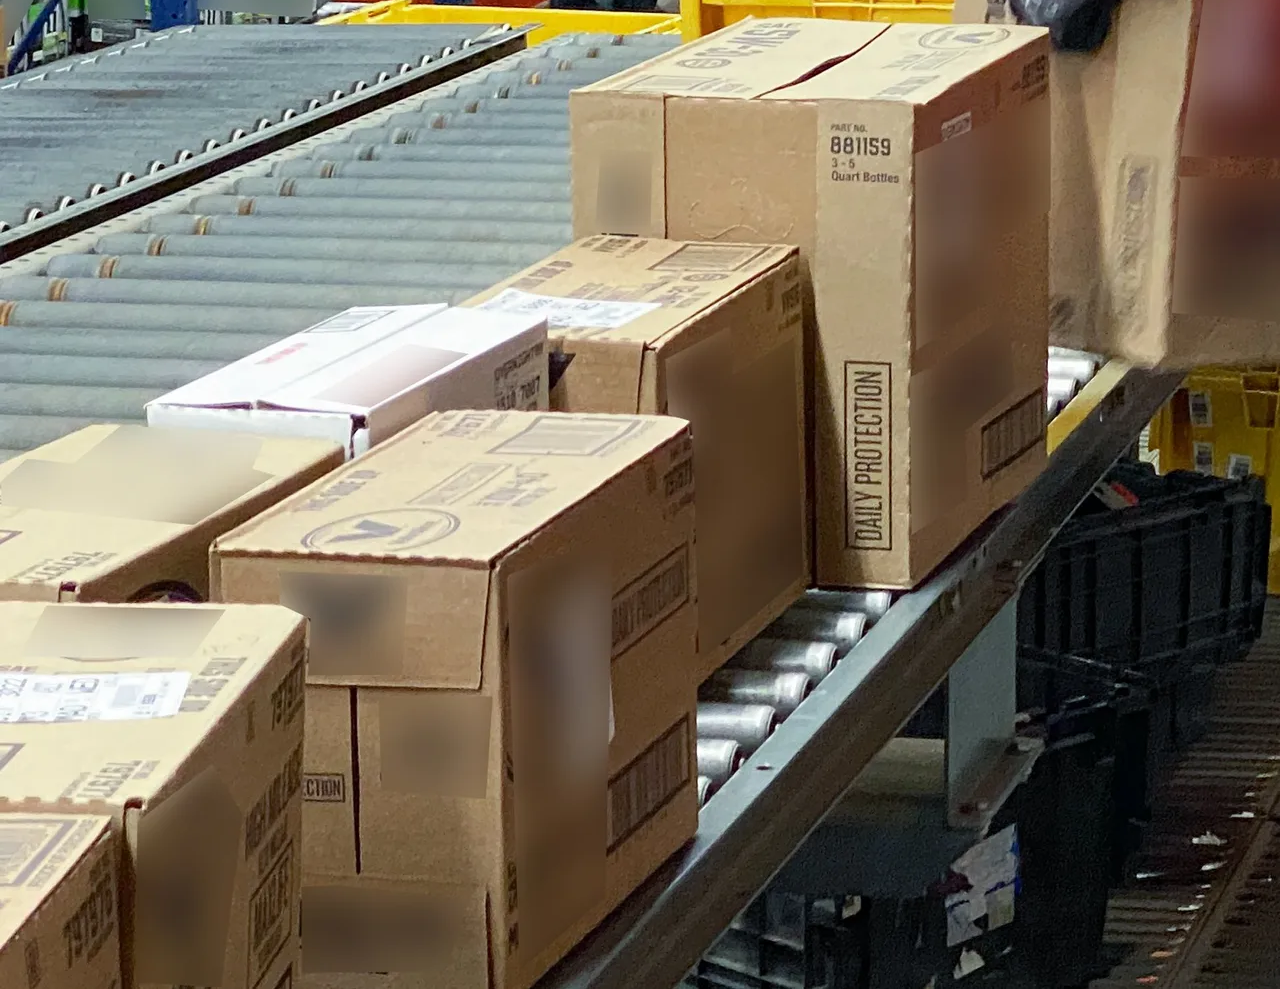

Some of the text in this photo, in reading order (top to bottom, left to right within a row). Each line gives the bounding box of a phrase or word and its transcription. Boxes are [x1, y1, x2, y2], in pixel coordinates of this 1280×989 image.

[831, 123, 852, 132] PART
[831, 136, 891, 156] 881159
[831, 171, 900, 183] Quart Bottles
[854, 371, 883, 541] DAILY PROTECTION
[303, 778, 341, 797] CTION
